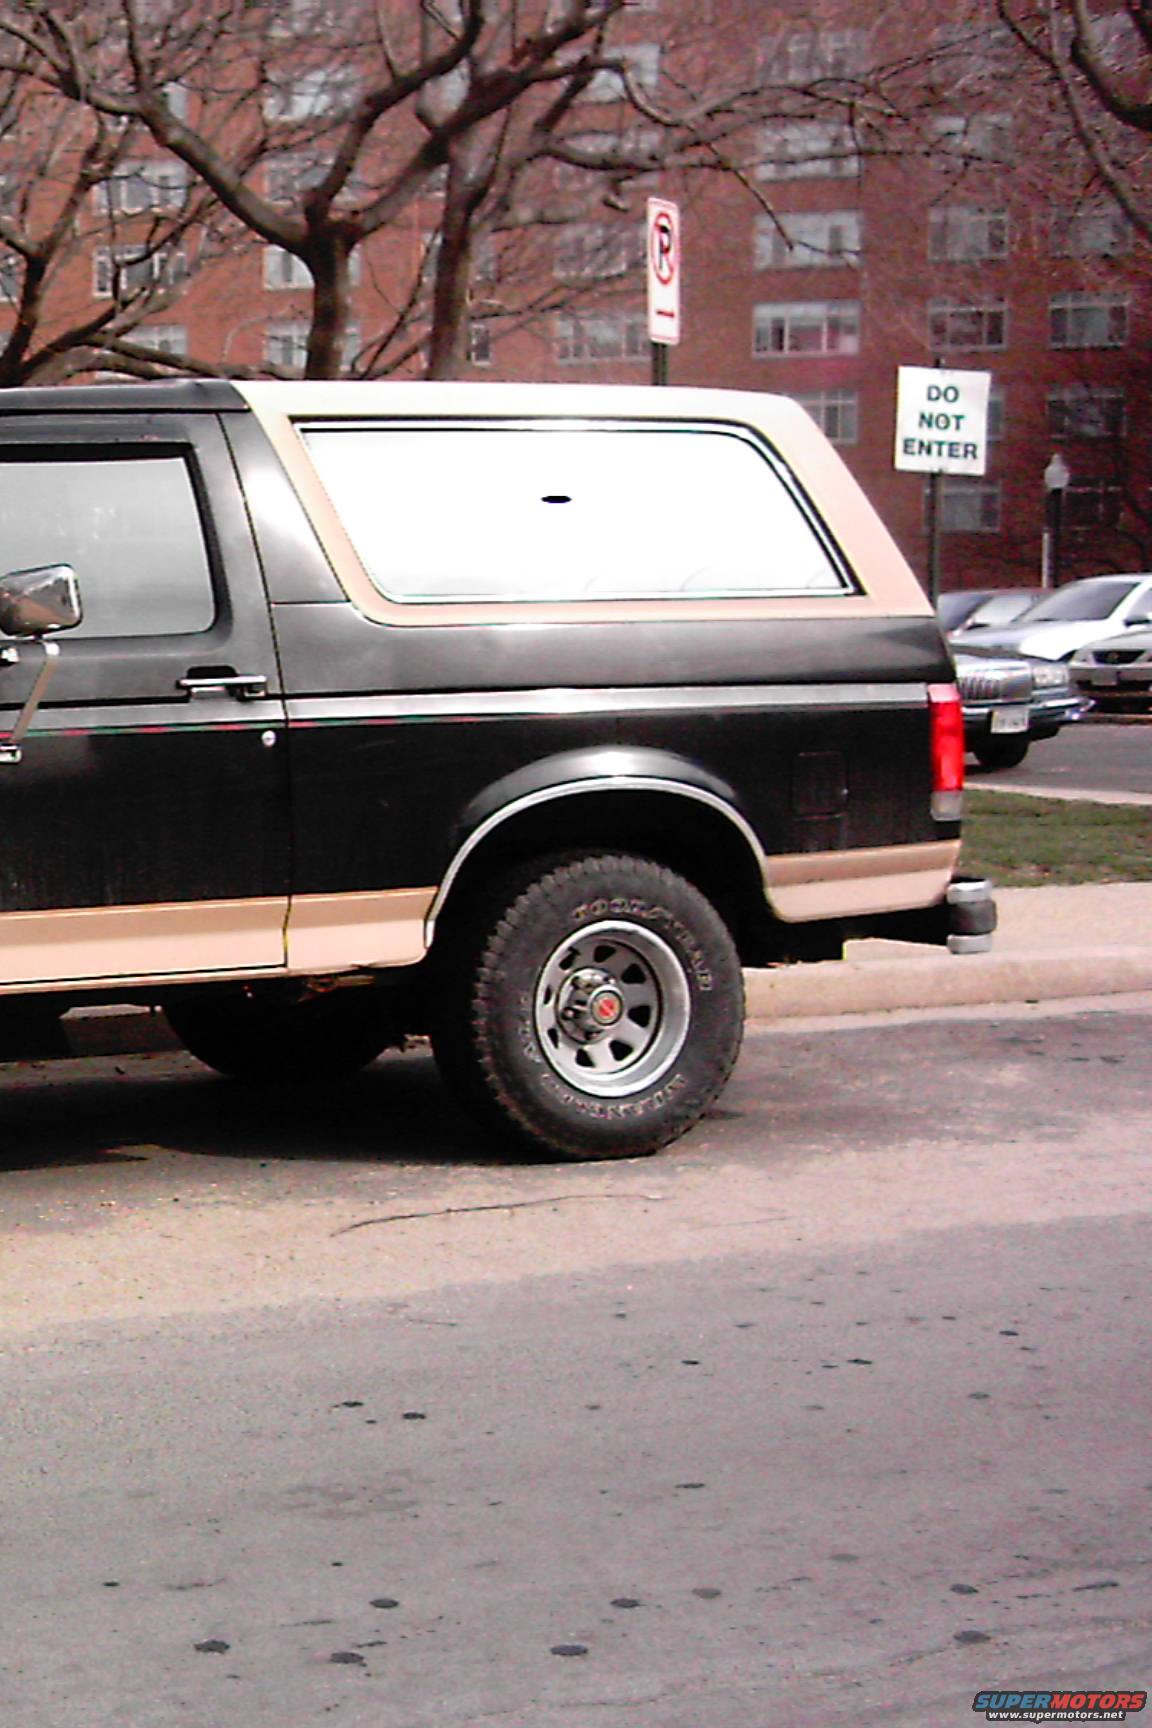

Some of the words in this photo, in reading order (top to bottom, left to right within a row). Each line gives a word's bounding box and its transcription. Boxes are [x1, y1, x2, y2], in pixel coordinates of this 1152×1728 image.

[927, 385, 959, 403] DO
[918, 411, 965, 431] NOT
[903, 437, 978, 459] ENTER
